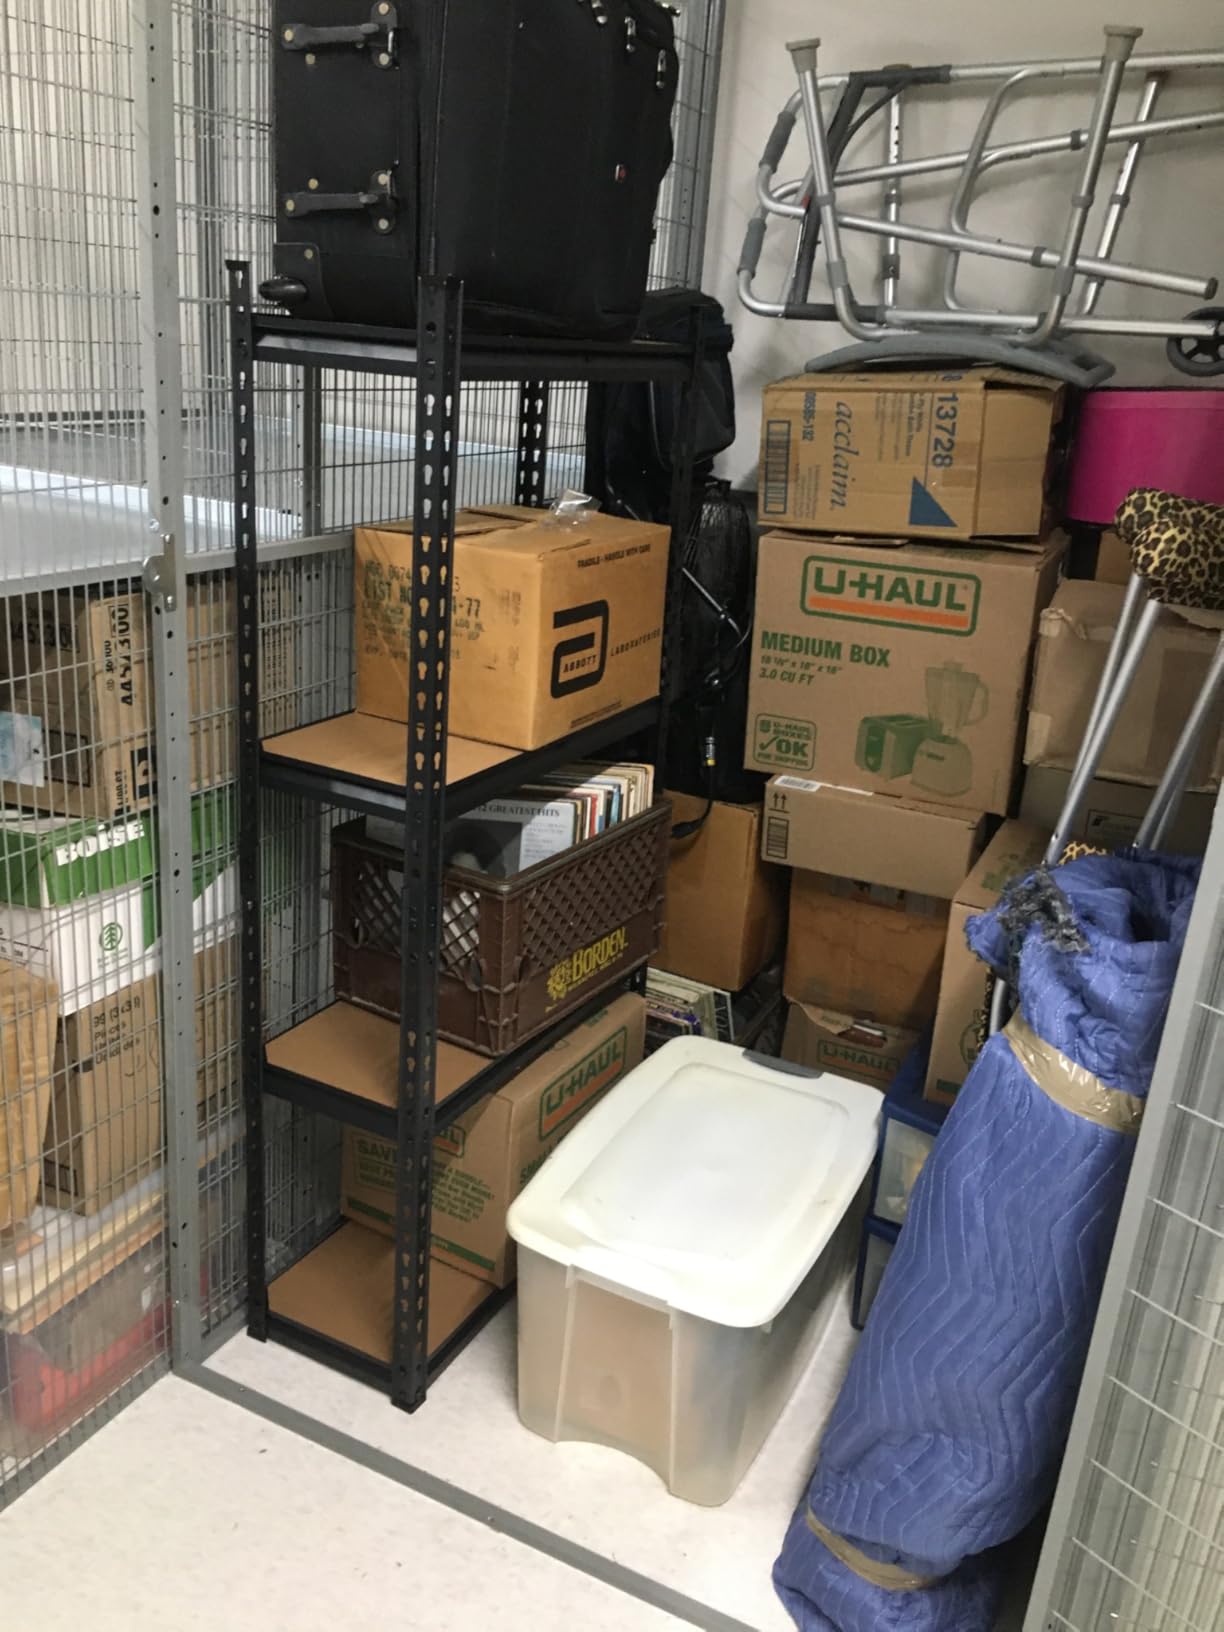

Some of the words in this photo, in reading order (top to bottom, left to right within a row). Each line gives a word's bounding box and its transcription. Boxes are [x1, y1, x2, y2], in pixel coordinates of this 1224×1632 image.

[932, 392, 959, 469] 13728
[829, 401, 860, 511] acclaim
[813, 566, 968, 612] U-HAUL
[563, 655, 598, 674] ABBOTT
[761, 630, 843, 661] MEDIUM
[849, 644, 891, 668] BOX
[759, 667, 778, 680] 3.0
[780, 670, 796, 683] CU
[797, 674, 815, 686] FT
[775, 738, 809, 758] OK
[572, 926, 627, 982] BORDEN
[545, 1040, 623, 1116] U-HAUL
